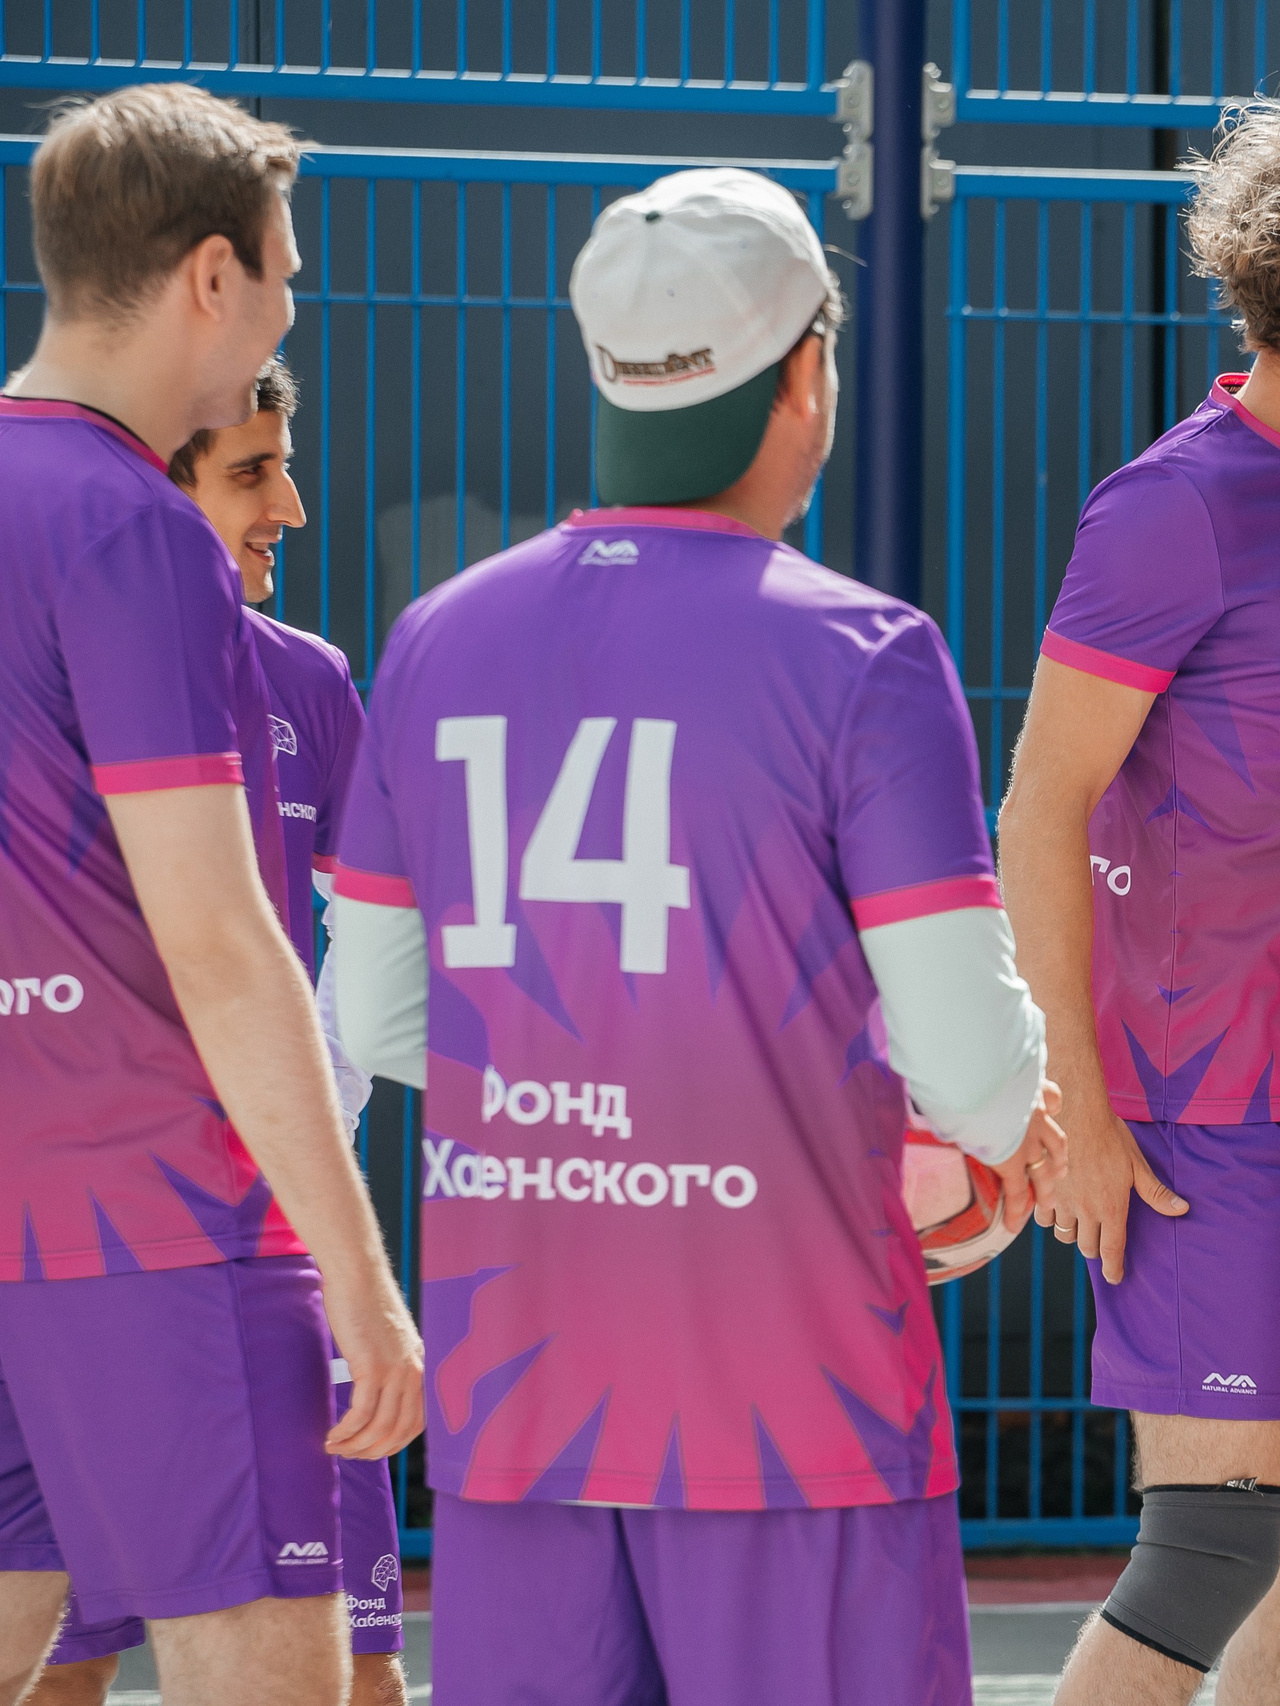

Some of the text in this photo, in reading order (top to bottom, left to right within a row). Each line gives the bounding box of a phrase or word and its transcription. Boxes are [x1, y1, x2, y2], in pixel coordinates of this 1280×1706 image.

[435, 715, 691, 974] 14
[421, 1138, 758, 1209] Хаенского
[1202, 1385, 1257, 1395] NATURAL ADVANCE
[346, 1594, 386, 1610] Фонд
